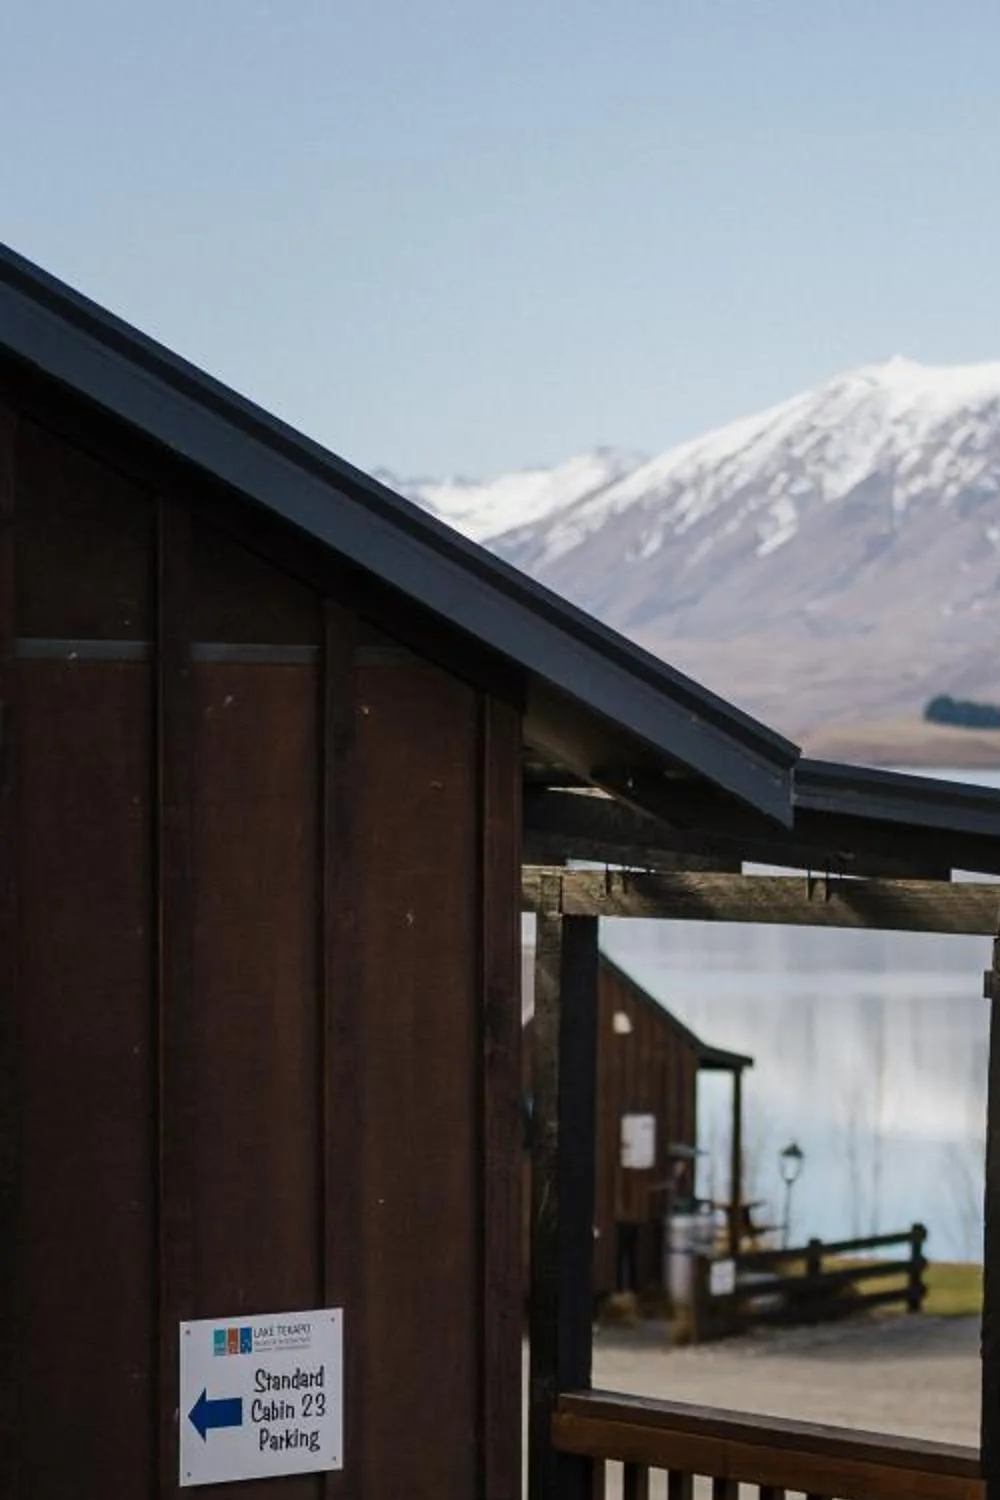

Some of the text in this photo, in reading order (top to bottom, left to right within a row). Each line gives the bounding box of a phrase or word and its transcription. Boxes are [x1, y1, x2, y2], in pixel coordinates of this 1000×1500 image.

[254, 1327, 274, 1338] LAKE
[254, 1365, 325, 1393] Standard
[251, 1393, 326, 1423] Cabin 23
[259, 1428, 321, 1452] Parking
